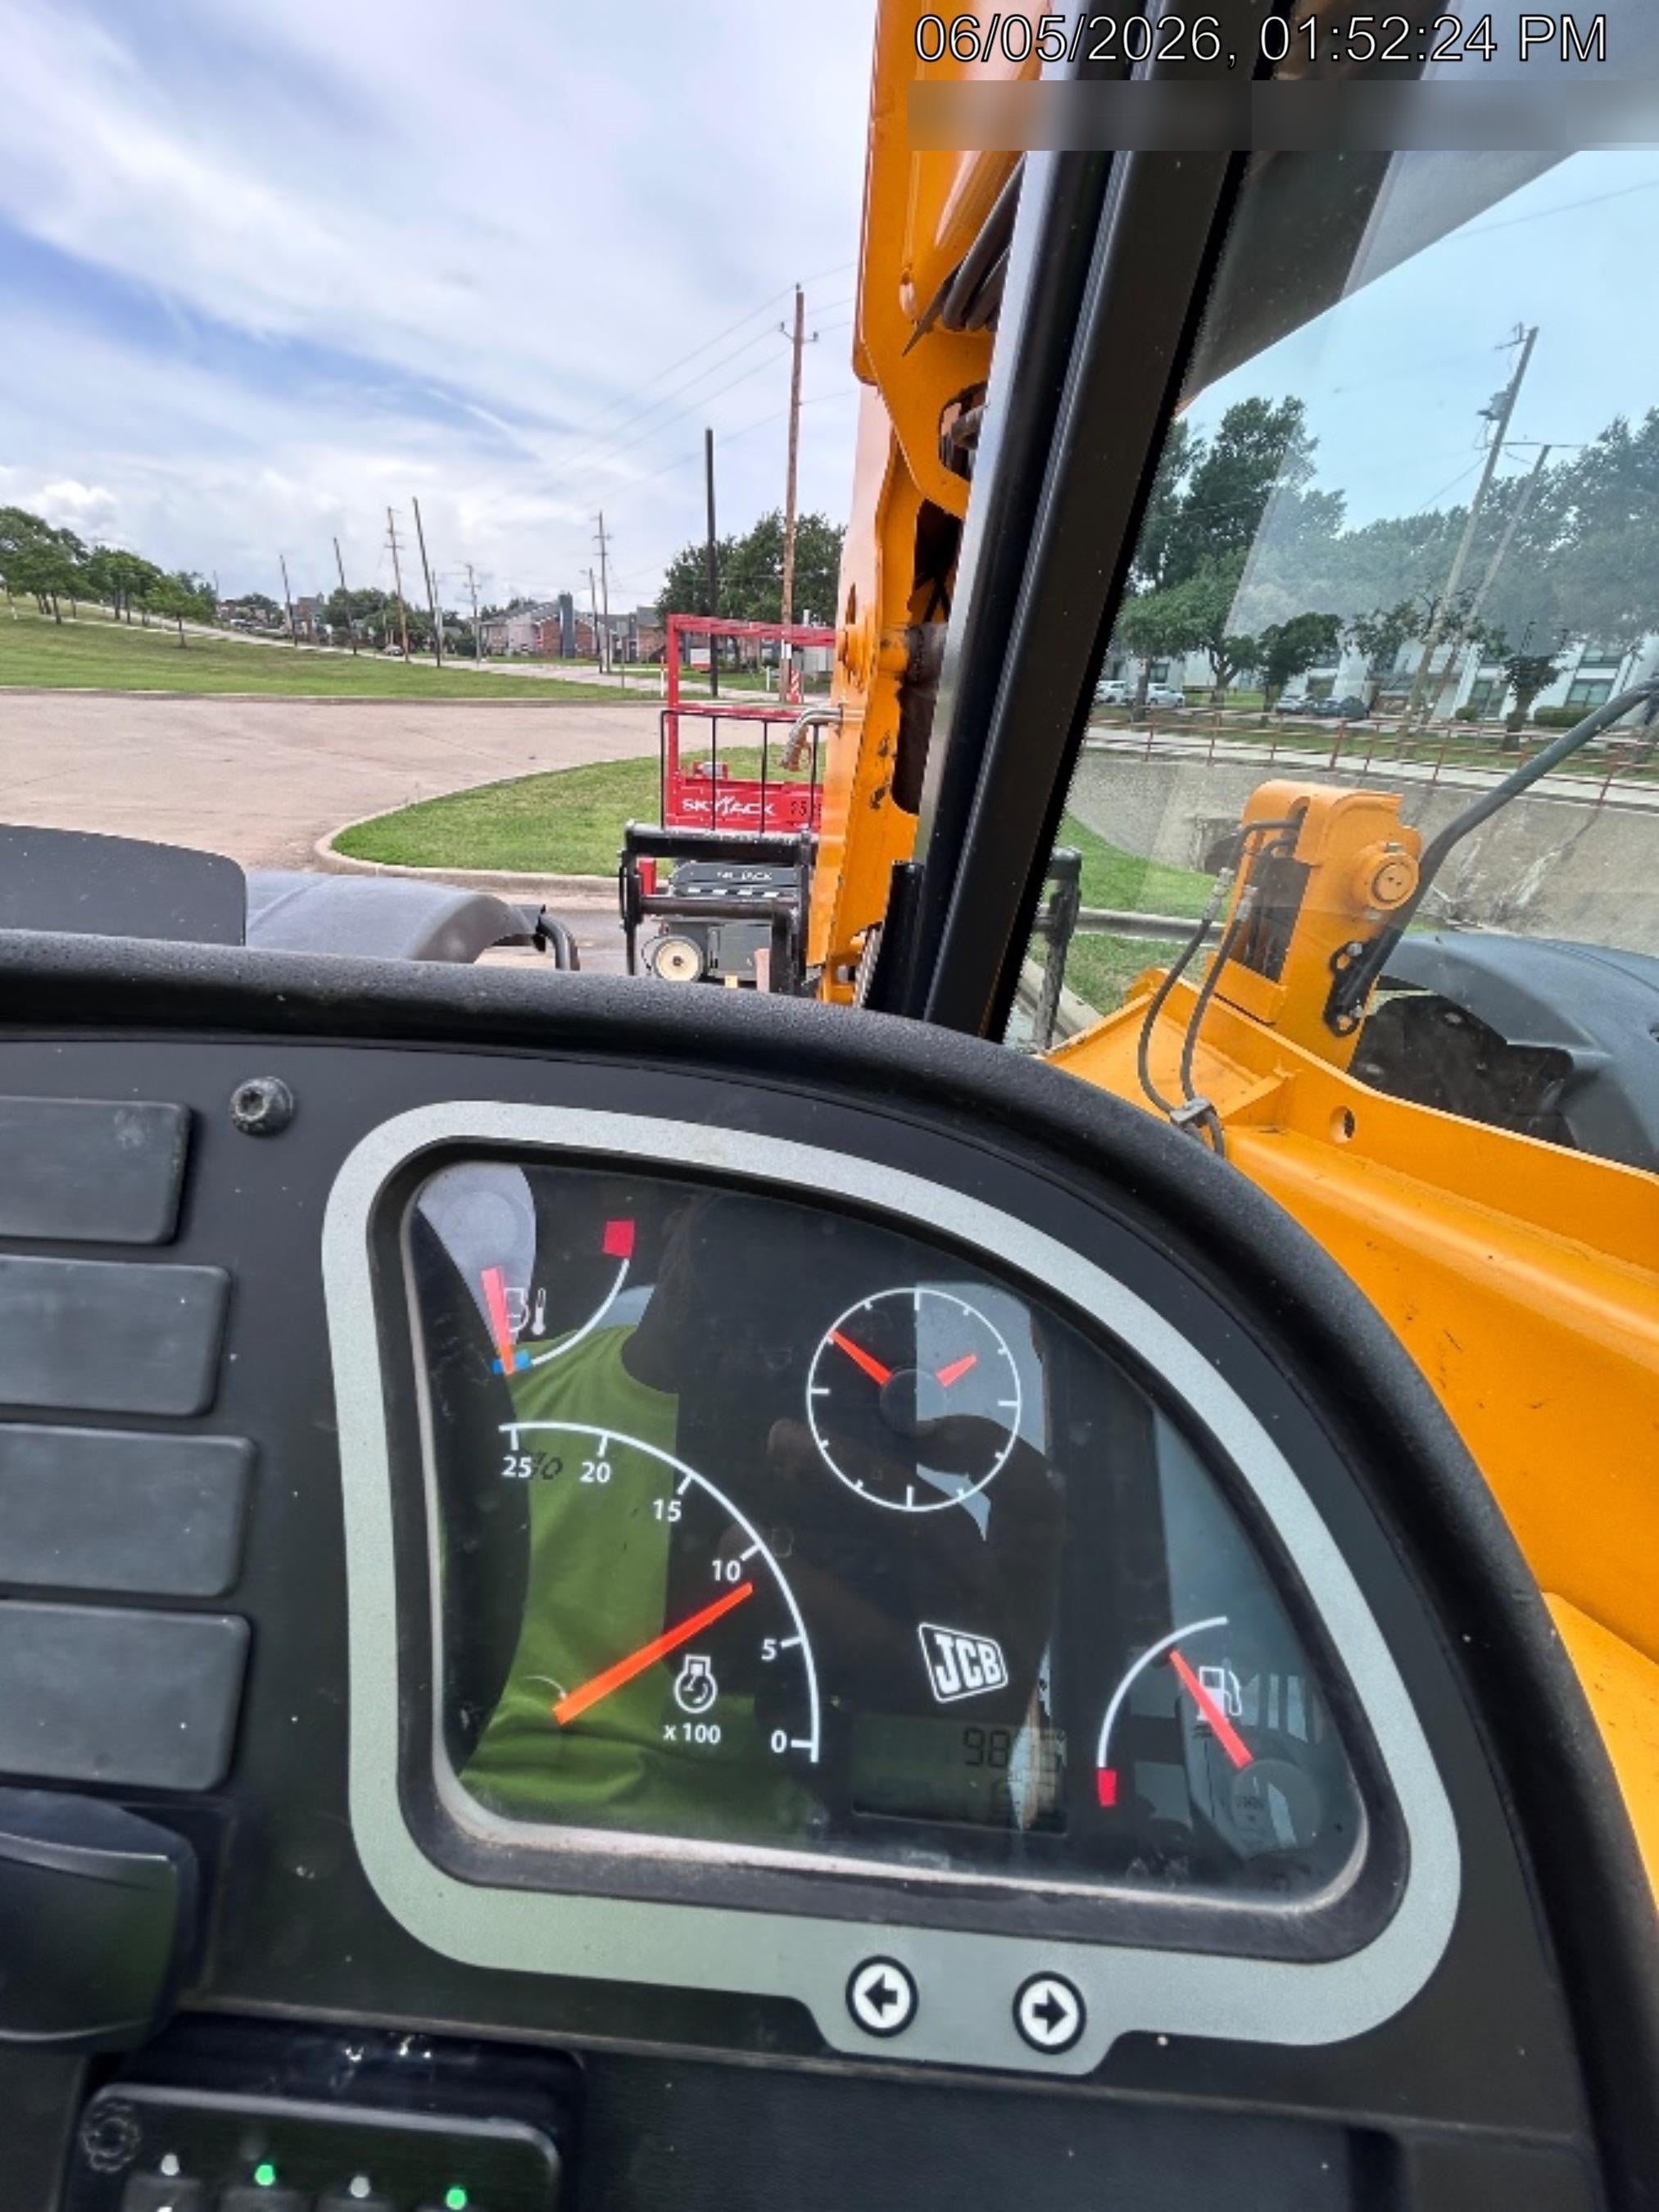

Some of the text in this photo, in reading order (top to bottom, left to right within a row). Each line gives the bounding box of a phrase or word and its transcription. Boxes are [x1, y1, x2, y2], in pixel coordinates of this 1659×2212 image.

[682, 796, 776, 817] SKYJACK
[501, 1455, 533, 1478] 25
[579, 1461, 611, 1484] 20
[653, 1498, 682, 1522] 15
[711, 1559, 741, 1582] 10
[761, 1639, 777, 1661] 5
[933, 1633, 1001, 1695] JCB
[682, 1722, 722, 1745] 100
[770, 1729, 787, 1753] 0
